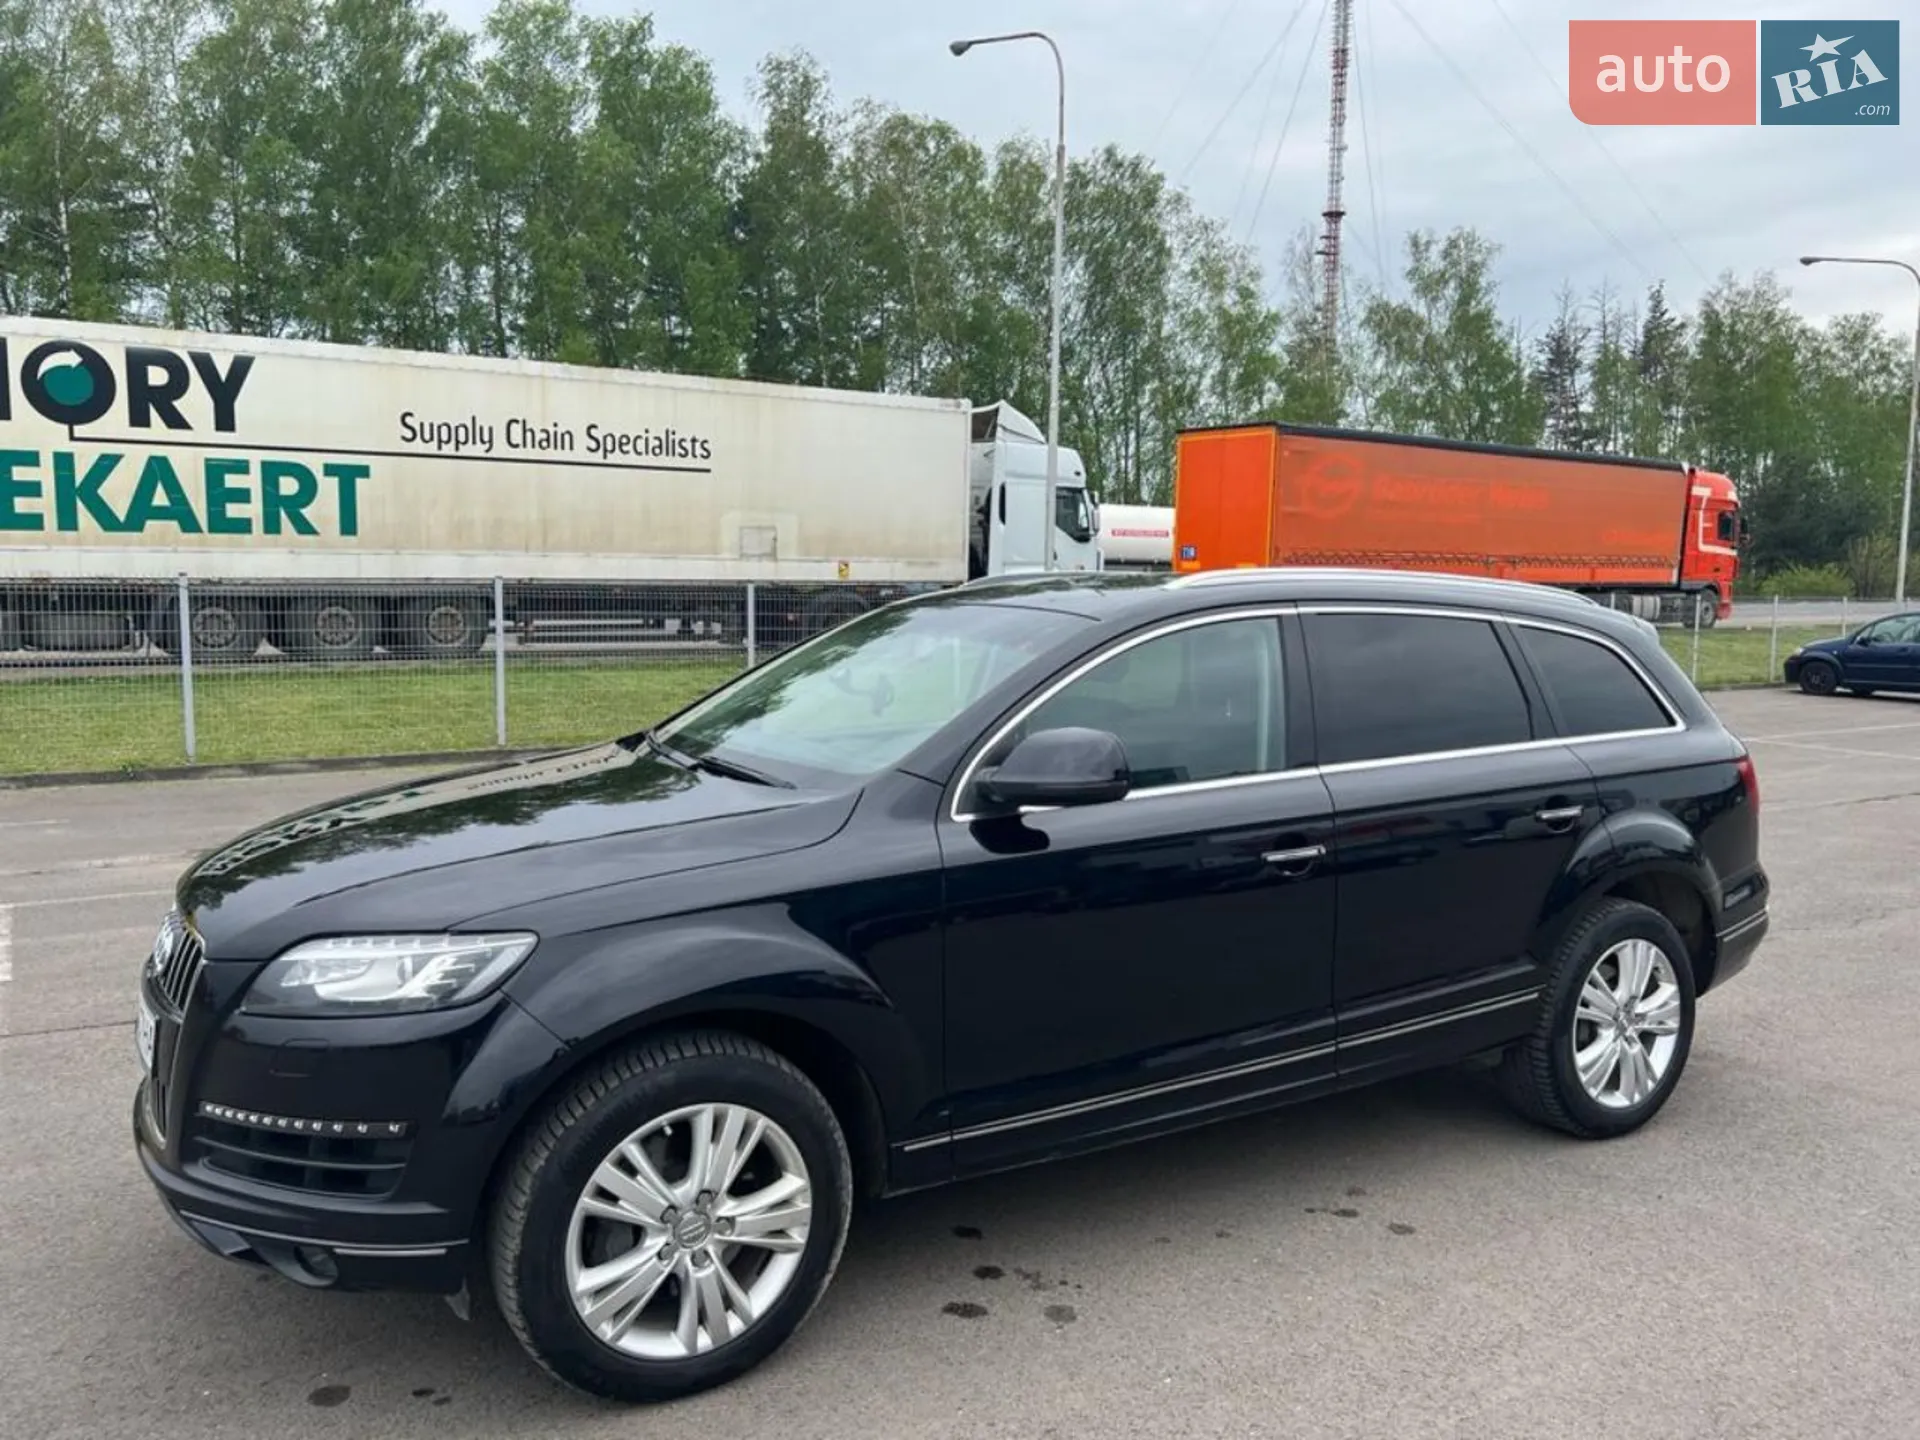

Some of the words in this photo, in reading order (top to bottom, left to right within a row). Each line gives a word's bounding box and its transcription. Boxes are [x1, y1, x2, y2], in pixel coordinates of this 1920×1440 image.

[0, 337, 256, 433] ORY
[400, 411, 494, 453] Supply
[505, 418, 575, 451] Chain
[586, 424, 712, 460] Specialists
[0, 449, 371, 537] EKAERT
